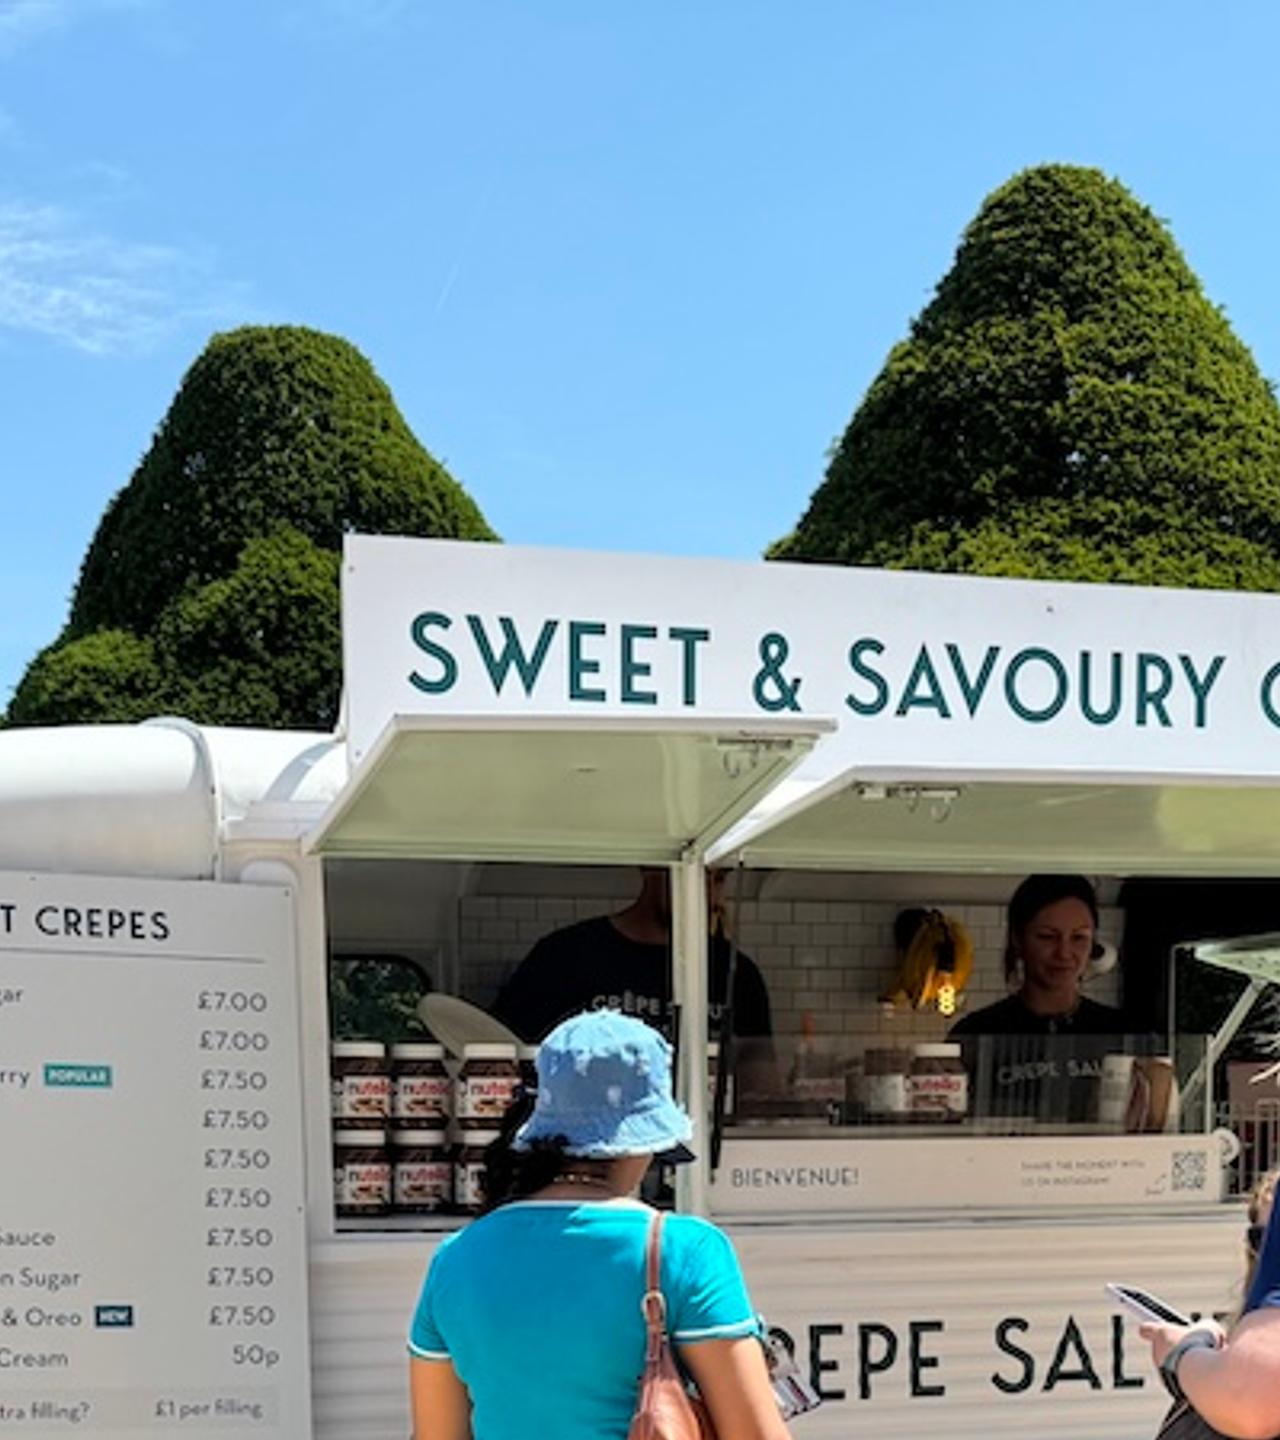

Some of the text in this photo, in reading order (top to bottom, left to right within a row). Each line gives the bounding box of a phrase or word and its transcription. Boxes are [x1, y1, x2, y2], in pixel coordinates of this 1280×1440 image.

[408, 611, 710, 706] SWEET
[753, 632, 802, 712] &
[846, 638, 1226, 728] SAVOURY
[35, 906, 169, 940] CREPES
[198, 992, 267, 1012] £7.00
[199, 1031, 269, 1051] £7.00
[48, 1068, 107, 1083] POPULAR
[201, 1070, 267, 1091] £7.50
[202, 1110, 269, 1130] £7.50
[205, 1149, 270, 1169] £7.50
[731, 1167, 858, 1187] BIENVENUE!
[205, 1188, 271, 1208] £7.50
[206, 1228, 273, 1247] £7.50
[20, 1267, 80, 1291] Sugar
[208, 1267, 274, 1287] £7.50
[1, 1309, 17, 1326] &
[25, 1307, 82, 1327] Oreo
[99, 1309, 129, 1322] NEW
[209, 1306, 276, 1326] £7.50
[233, 1344, 279, 1368] 50p
[31, 1401, 91, 1424] filling?
[155, 1398, 263, 1421] £1 per filling
